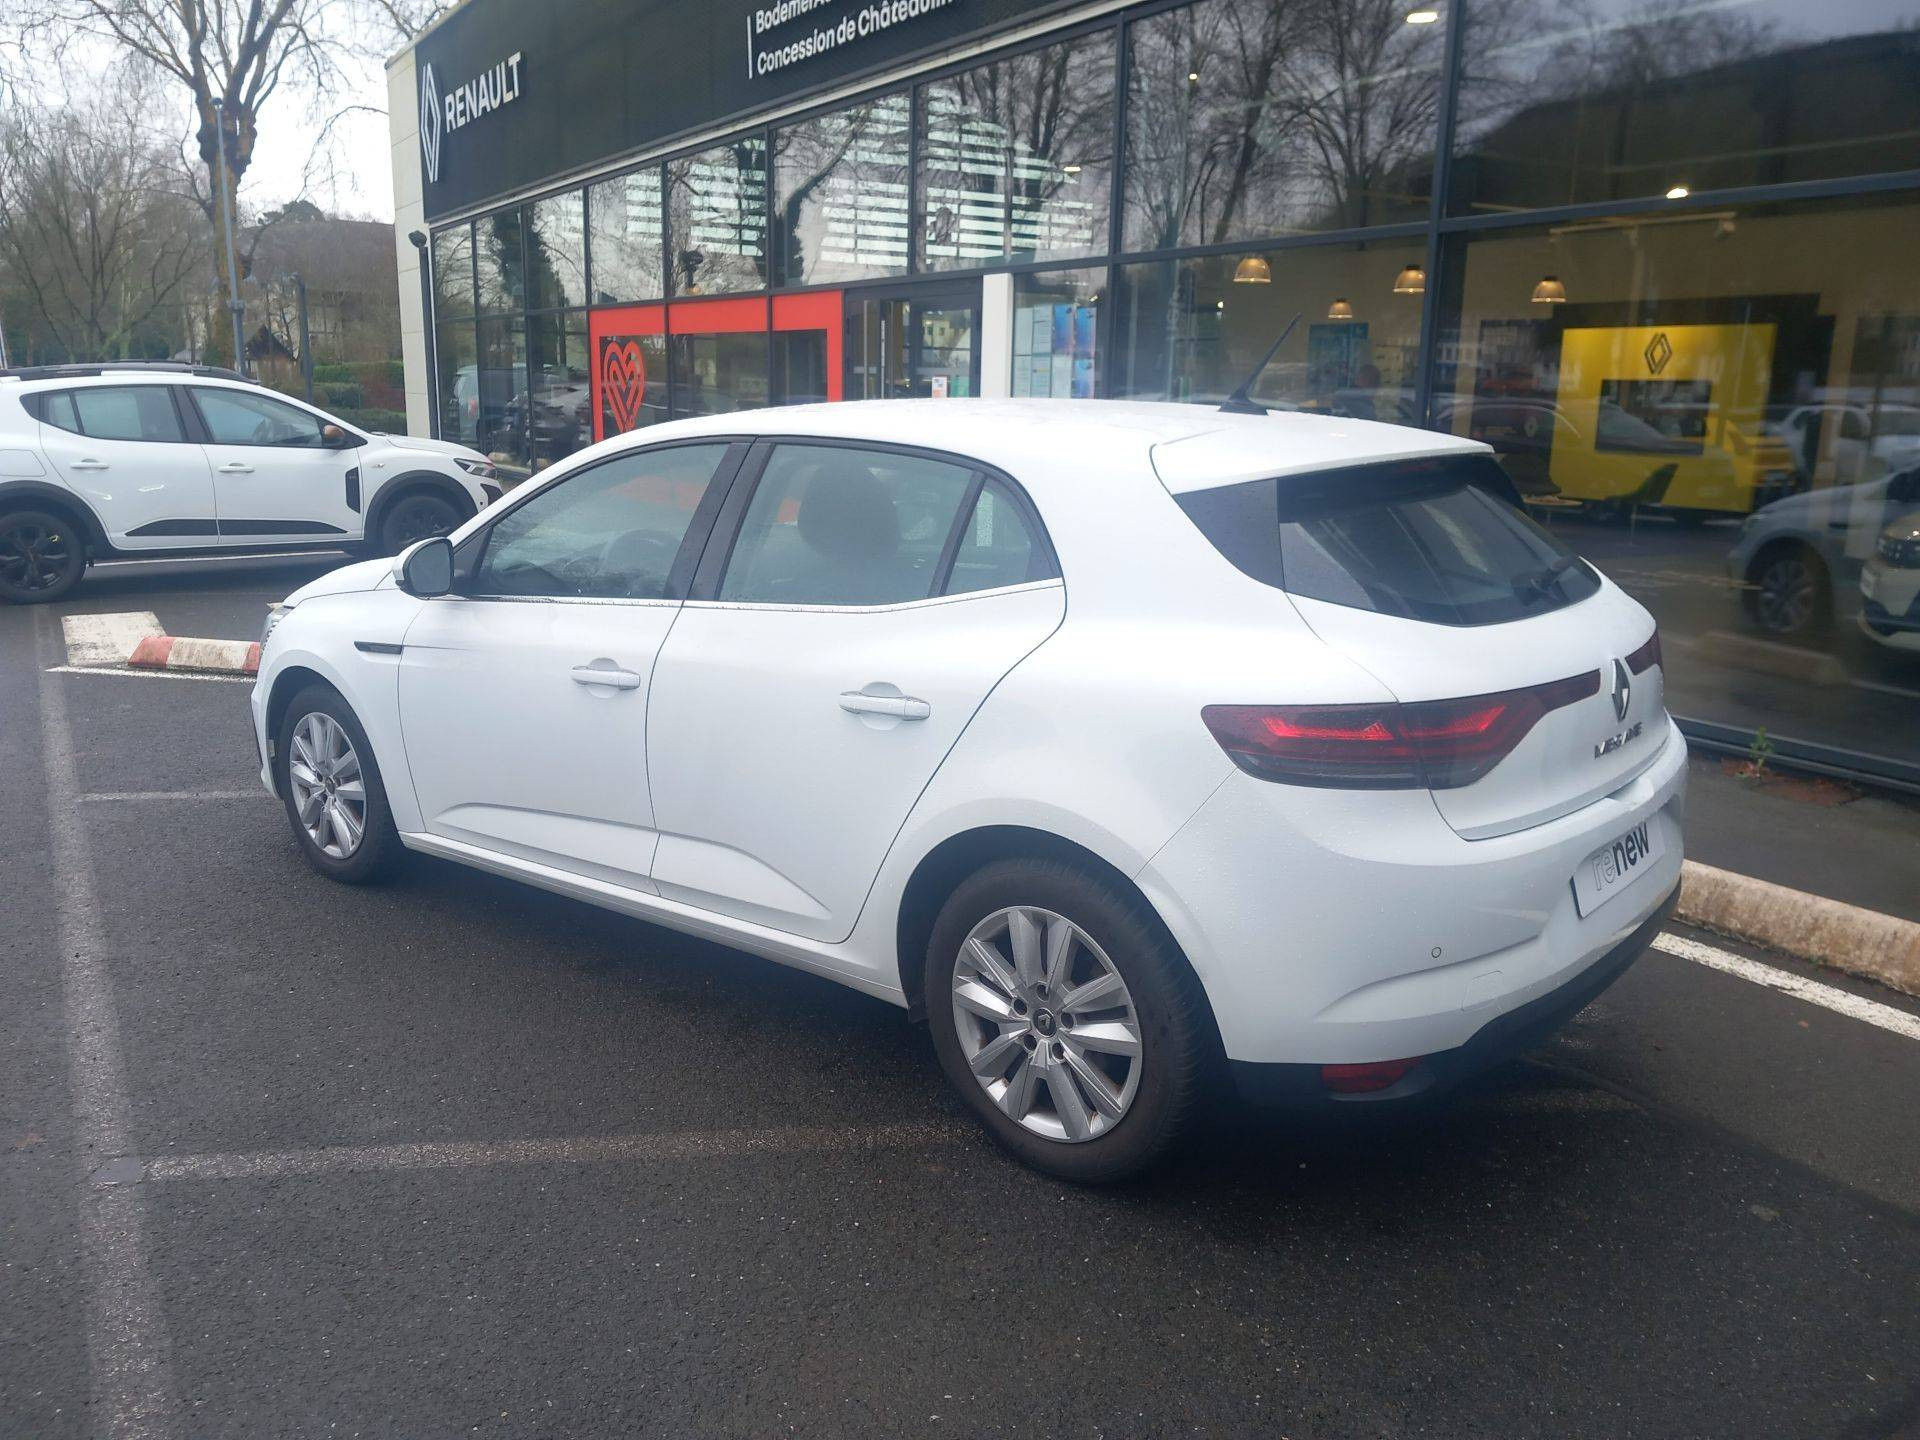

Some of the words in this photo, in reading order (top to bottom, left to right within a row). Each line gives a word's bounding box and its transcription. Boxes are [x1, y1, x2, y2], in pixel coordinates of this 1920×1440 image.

[757, 28, 835, 76] Concession
[836, 15, 856, 42] de
[444, 51, 521, 134] RENAULT
[1591, 821, 1650, 892] renew
